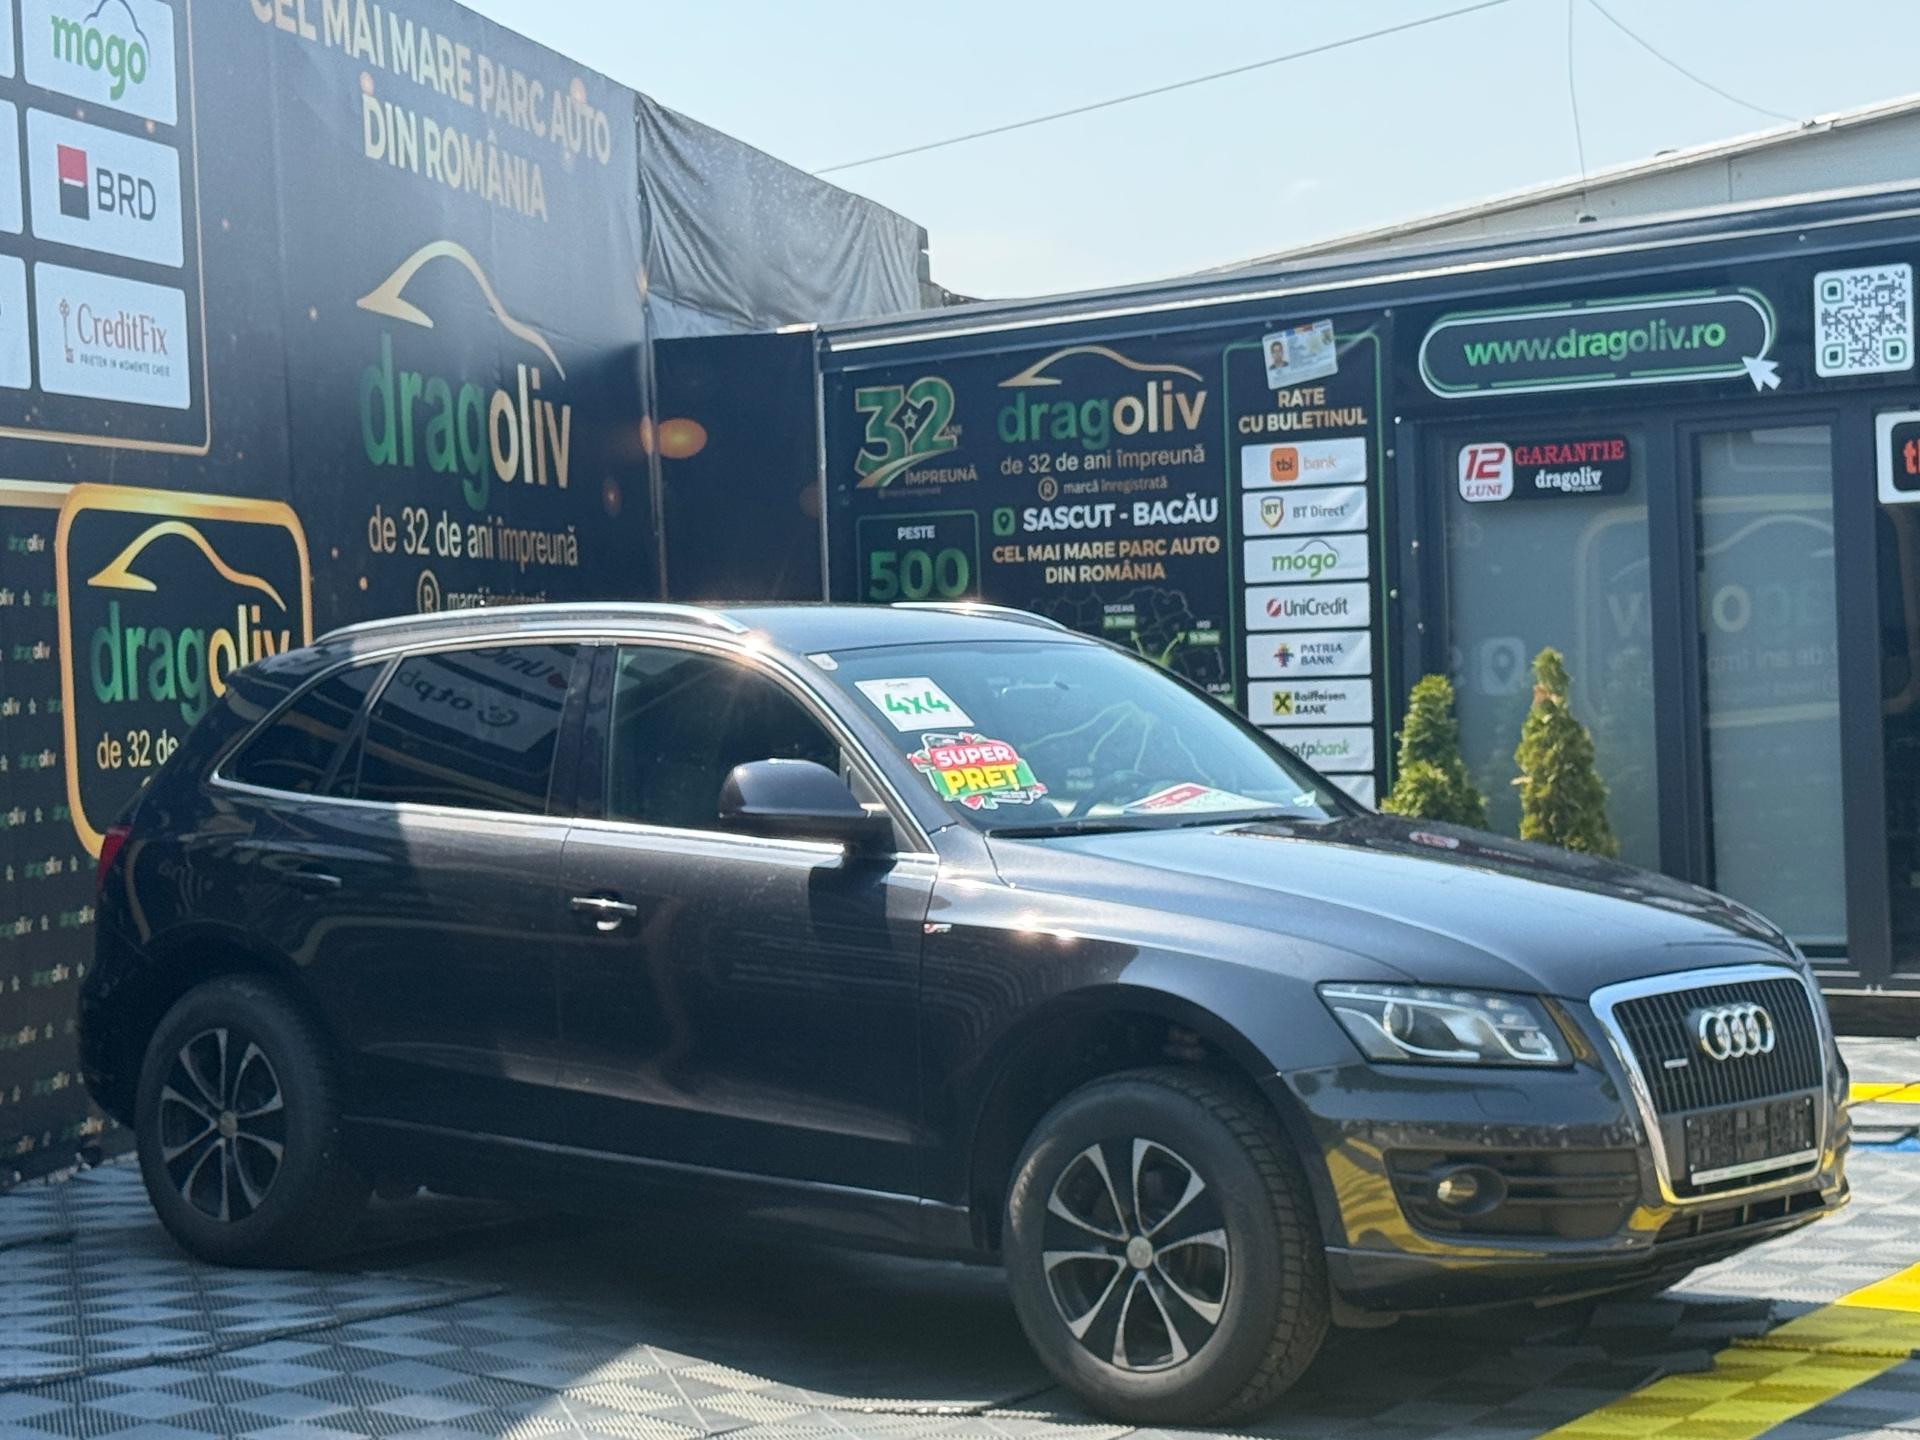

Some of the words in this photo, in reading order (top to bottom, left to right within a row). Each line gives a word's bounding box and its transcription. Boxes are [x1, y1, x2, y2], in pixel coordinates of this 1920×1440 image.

[51, 15, 146, 101] mogo
[322, 0, 385, 69] MAI
[389, 12, 474, 107] MARE
[478, 53, 546, 138] PARC
[551, 89, 611, 166] AUTO
[362, 93, 419, 175] DIN
[423, 117, 548, 223] ROMÂNIA
[96, 167, 156, 222] BRD
[77, 303, 168, 356] CreditFix
[1463, 318, 1726, 367] www.dragoliv.ro
[1278, 387, 1326, 408] RATE
[359, 331, 572, 512] dragoliv
[854, 376, 956, 482] 32
[997, 380, 1207, 450] dragoliv
[1238, 414, 1264, 434] CU
[1267, 407, 1368, 432] BULETINUL
[1000, 456, 1023, 475] de
[1028, 453, 1051, 474] 32
[1055, 452, 1079, 472] de
[1084, 450, 1111, 470] ani
[1117, 443, 1206, 471] împreună
[1275, 457, 1293, 472] tbi
[1465, 448, 1506, 481] 12
[1514, 440, 1625, 466] GARANTIE
[1466, 484, 1502, 497] LUNI
[1535, 466, 1603, 492] dragoliv
[1023, 503, 1116, 532] SASCUT
[1133, 492, 1219, 526] BACĂU
[1293, 507, 1308, 518] BT
[1311, 504, 1346, 518] Direct
[368, 504, 397, 554] de
[402, 506, 430, 556] 32
[435, 510, 463, 559] de
[467, 515, 493, 560] ani
[496, 515, 578, 574] împreună
[897, 525, 936, 541] PESTE
[992, 545, 1025, 563] CEL
[1027, 543, 1061, 562] MAI
[1064, 540, 1116, 560] MARE
[1119, 538, 1167, 558] PARC
[1170, 536, 1221, 555] AUTO
[869, 548, 969, 600] 500
[1045, 565, 1078, 584] DIN
[1080, 560, 1166, 583] ROMÂNIA
[1272, 553, 1337, 577] mogo
[1283, 597, 1348, 617] UniCredit
[1301, 643, 1344, 655] PATRIA
[1301, 655, 1334, 667] BANK
[96, 731, 122, 770] de
[126, 729, 151, 768] 32
[935, 745, 1013, 768] SUPER
